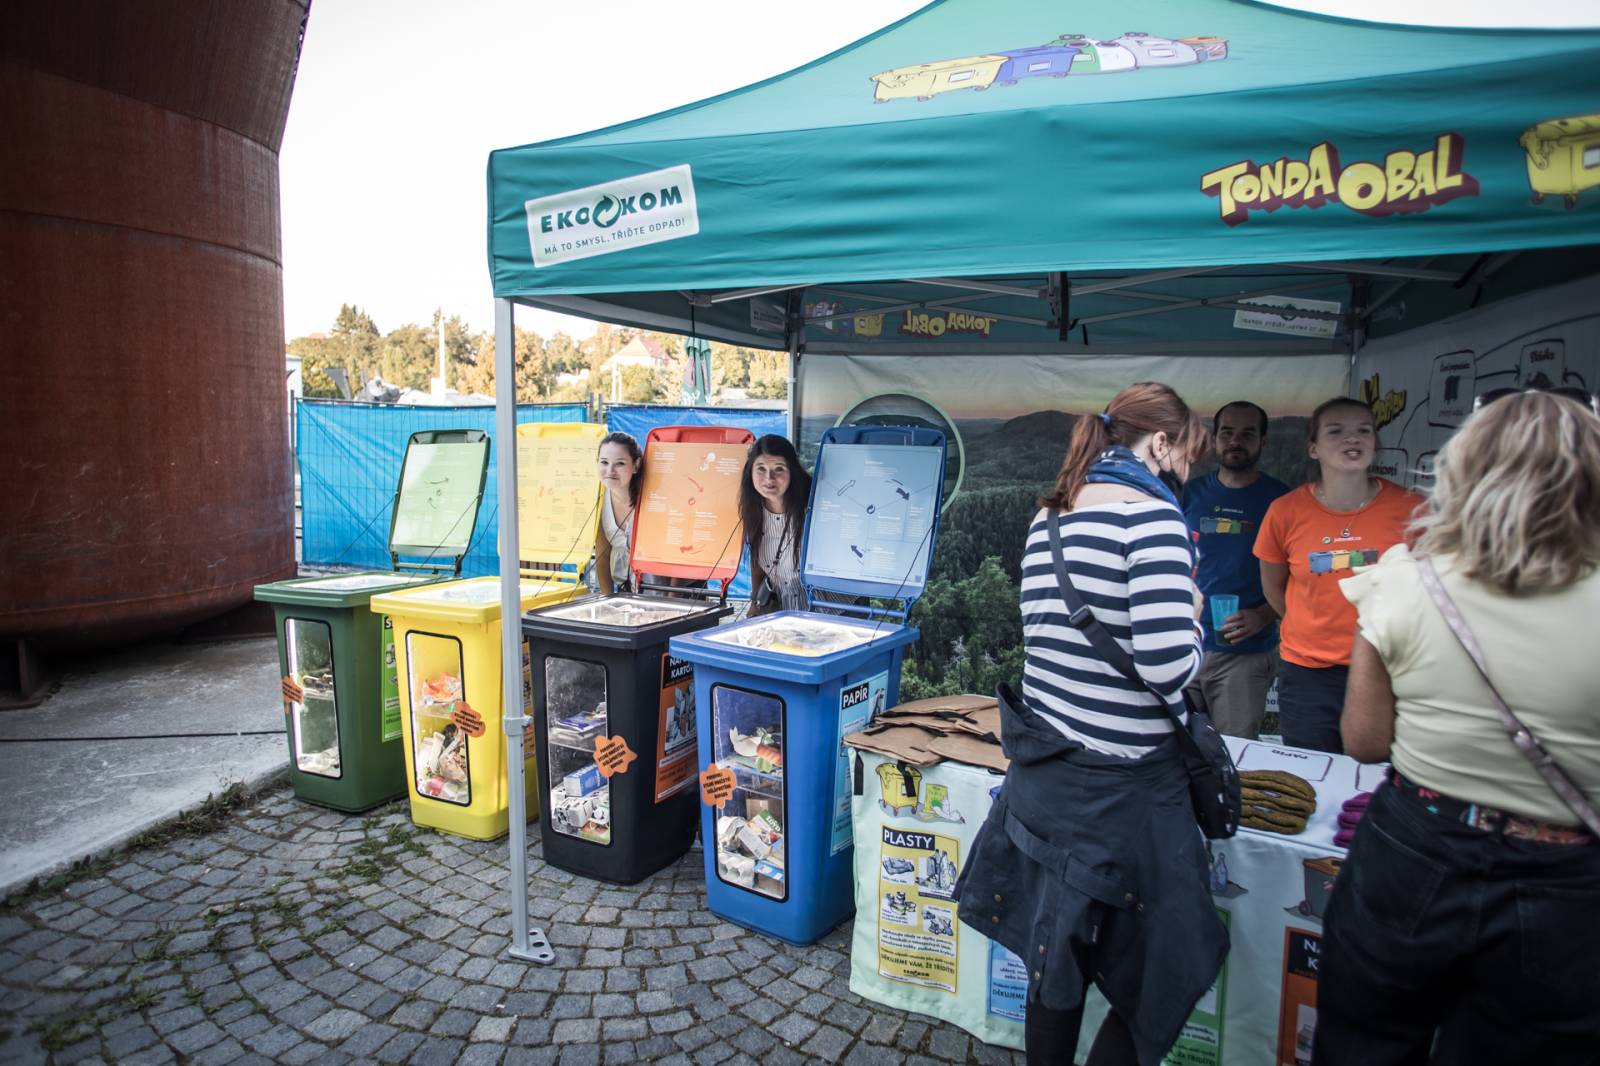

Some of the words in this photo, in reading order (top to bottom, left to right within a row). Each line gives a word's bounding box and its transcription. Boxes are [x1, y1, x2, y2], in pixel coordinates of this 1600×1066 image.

[1201, 143, 1336, 218] TONDA
[1337, 133, 1465, 212] OBAL
[544, 245, 558, 255] MÁ
[561, 241, 572, 251] TO
[575, 236, 610, 249] SMYSL,
[649, 217, 686, 232] ODPAD!
[842, 686, 868, 708] PAPÍR
[884, 829, 933, 849] PLASTY
